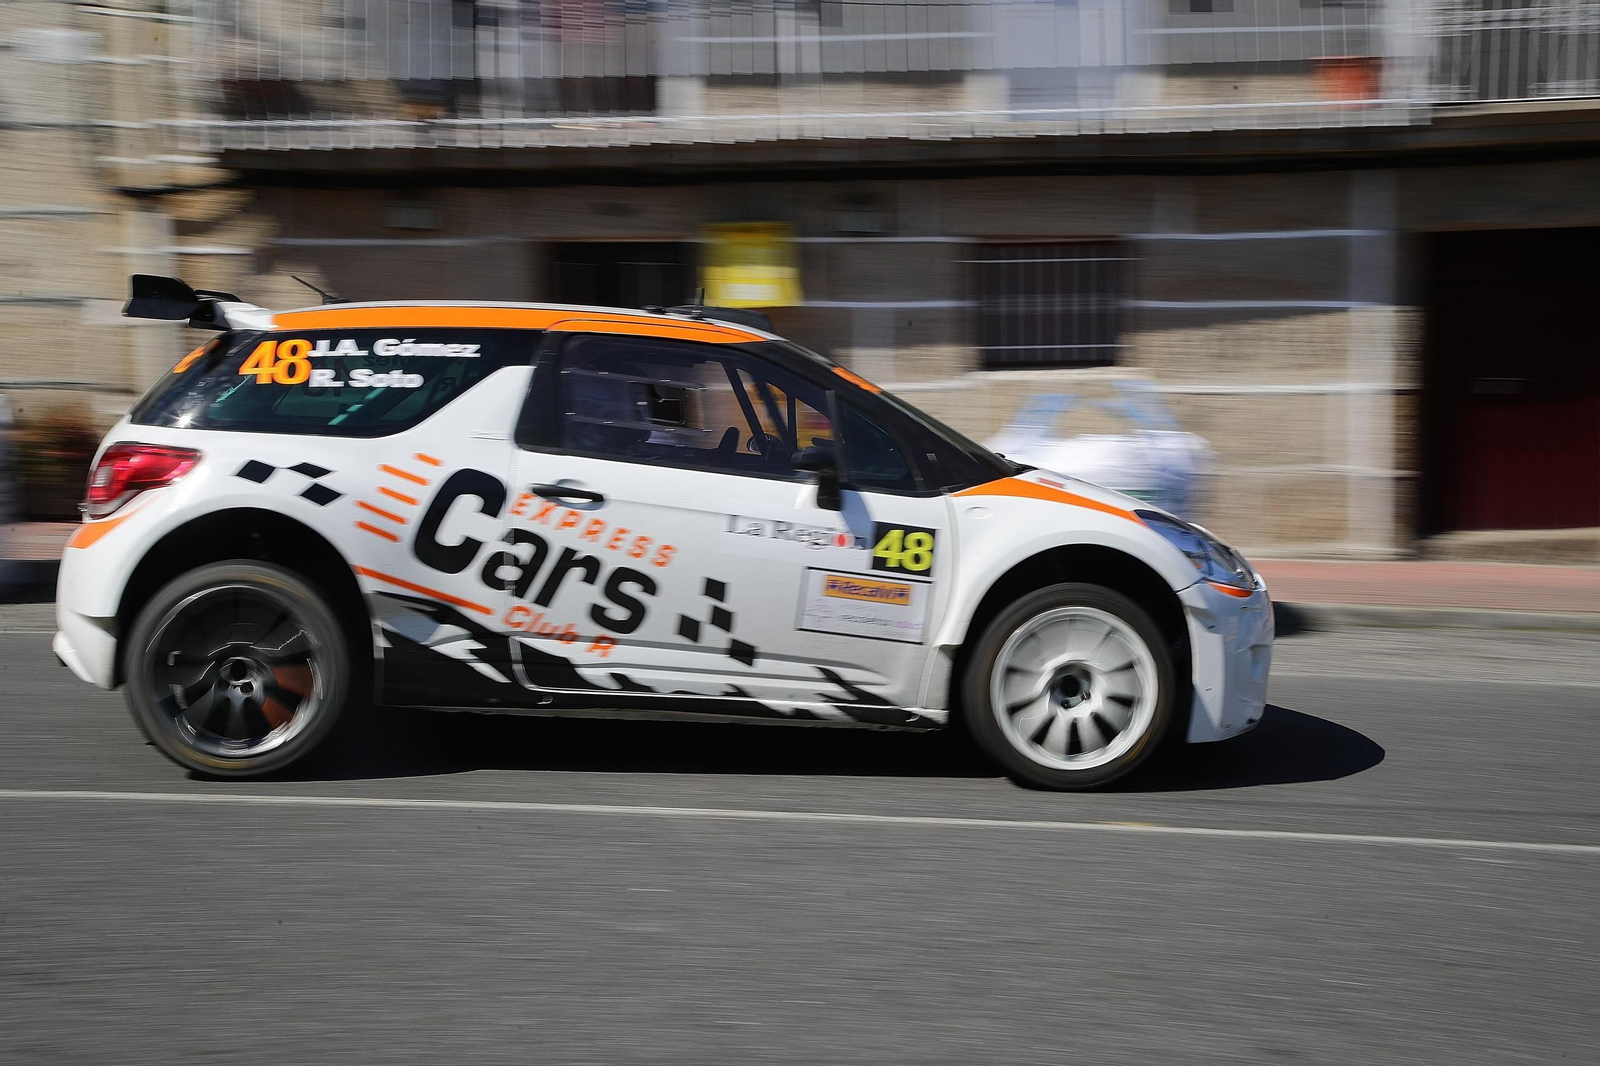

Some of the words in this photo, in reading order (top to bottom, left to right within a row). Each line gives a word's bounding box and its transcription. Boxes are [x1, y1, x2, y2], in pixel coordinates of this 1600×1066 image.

[238, 339, 313, 385] 48
[372, 338, 481, 358] Gómez
[348, 368, 425, 388] Soto
[508, 492, 678, 568] EXPRESS
[724, 513, 764, 538] La
[414, 467, 658, 635] Cars
[873, 529, 935, 571] 48
[502, 605, 579, 646] Club
[584, 634, 618, 658] R
